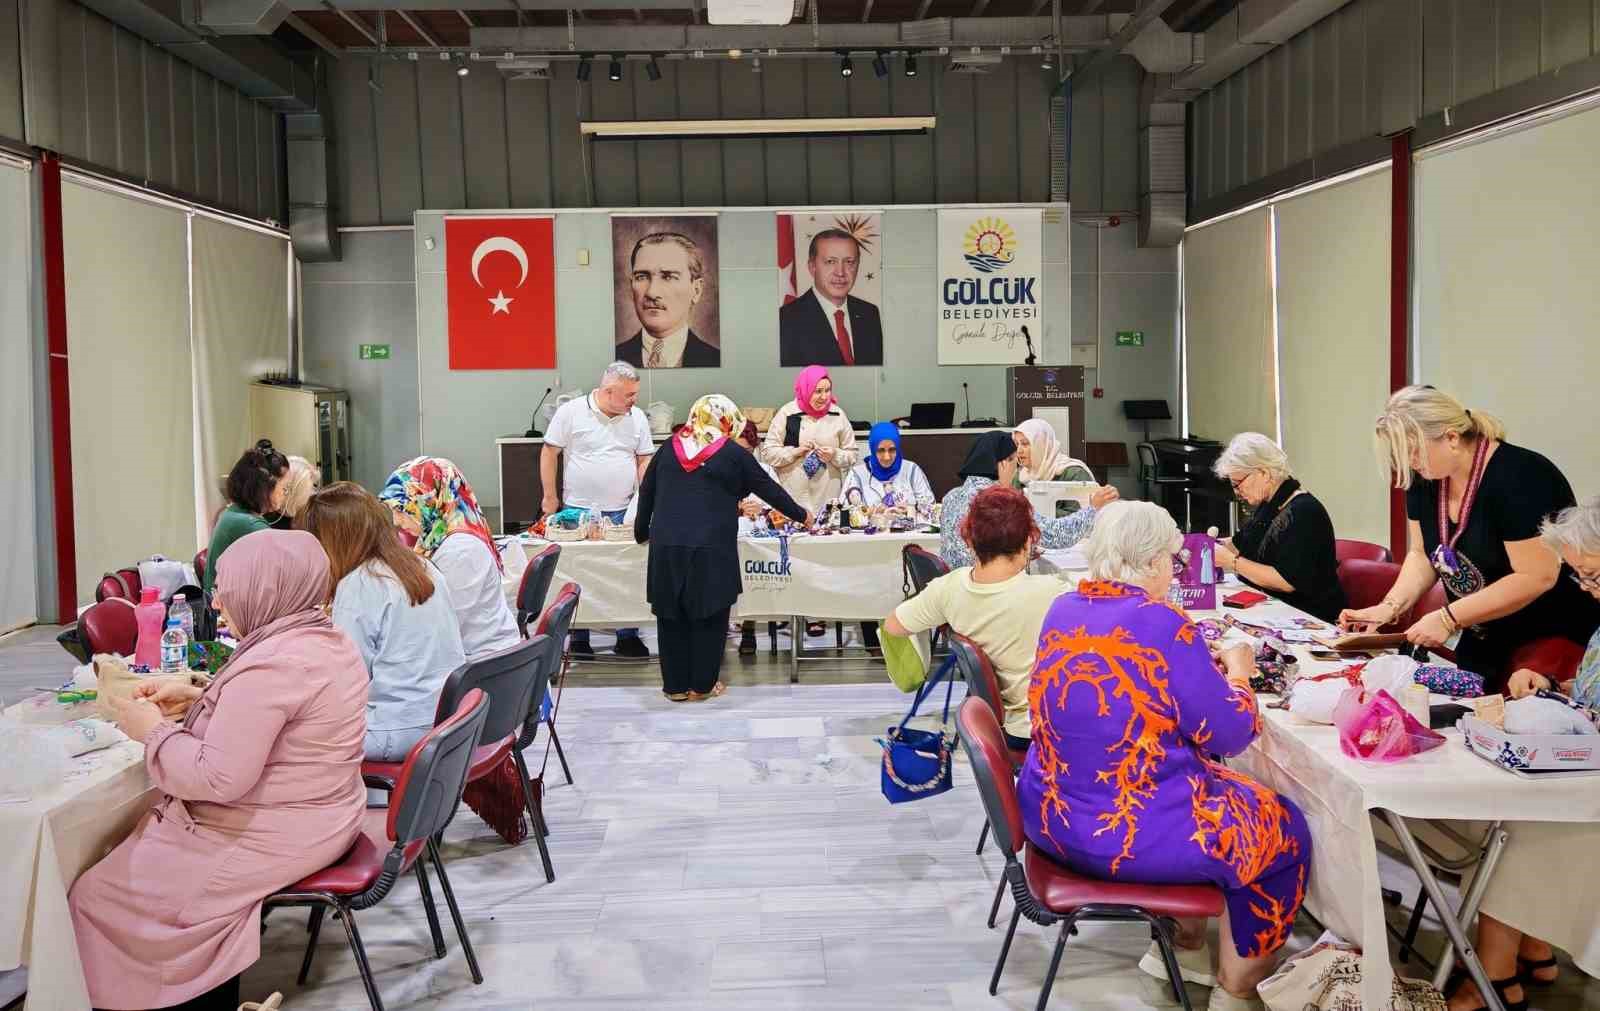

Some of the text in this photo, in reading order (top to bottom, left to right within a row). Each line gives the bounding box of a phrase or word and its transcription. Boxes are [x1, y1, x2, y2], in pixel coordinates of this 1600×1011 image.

[943, 277, 1036, 305] GÖLCÜK
[943, 306, 1037, 320] BELEDİYESİ
[744, 559, 792, 576] GÖLCÜK
